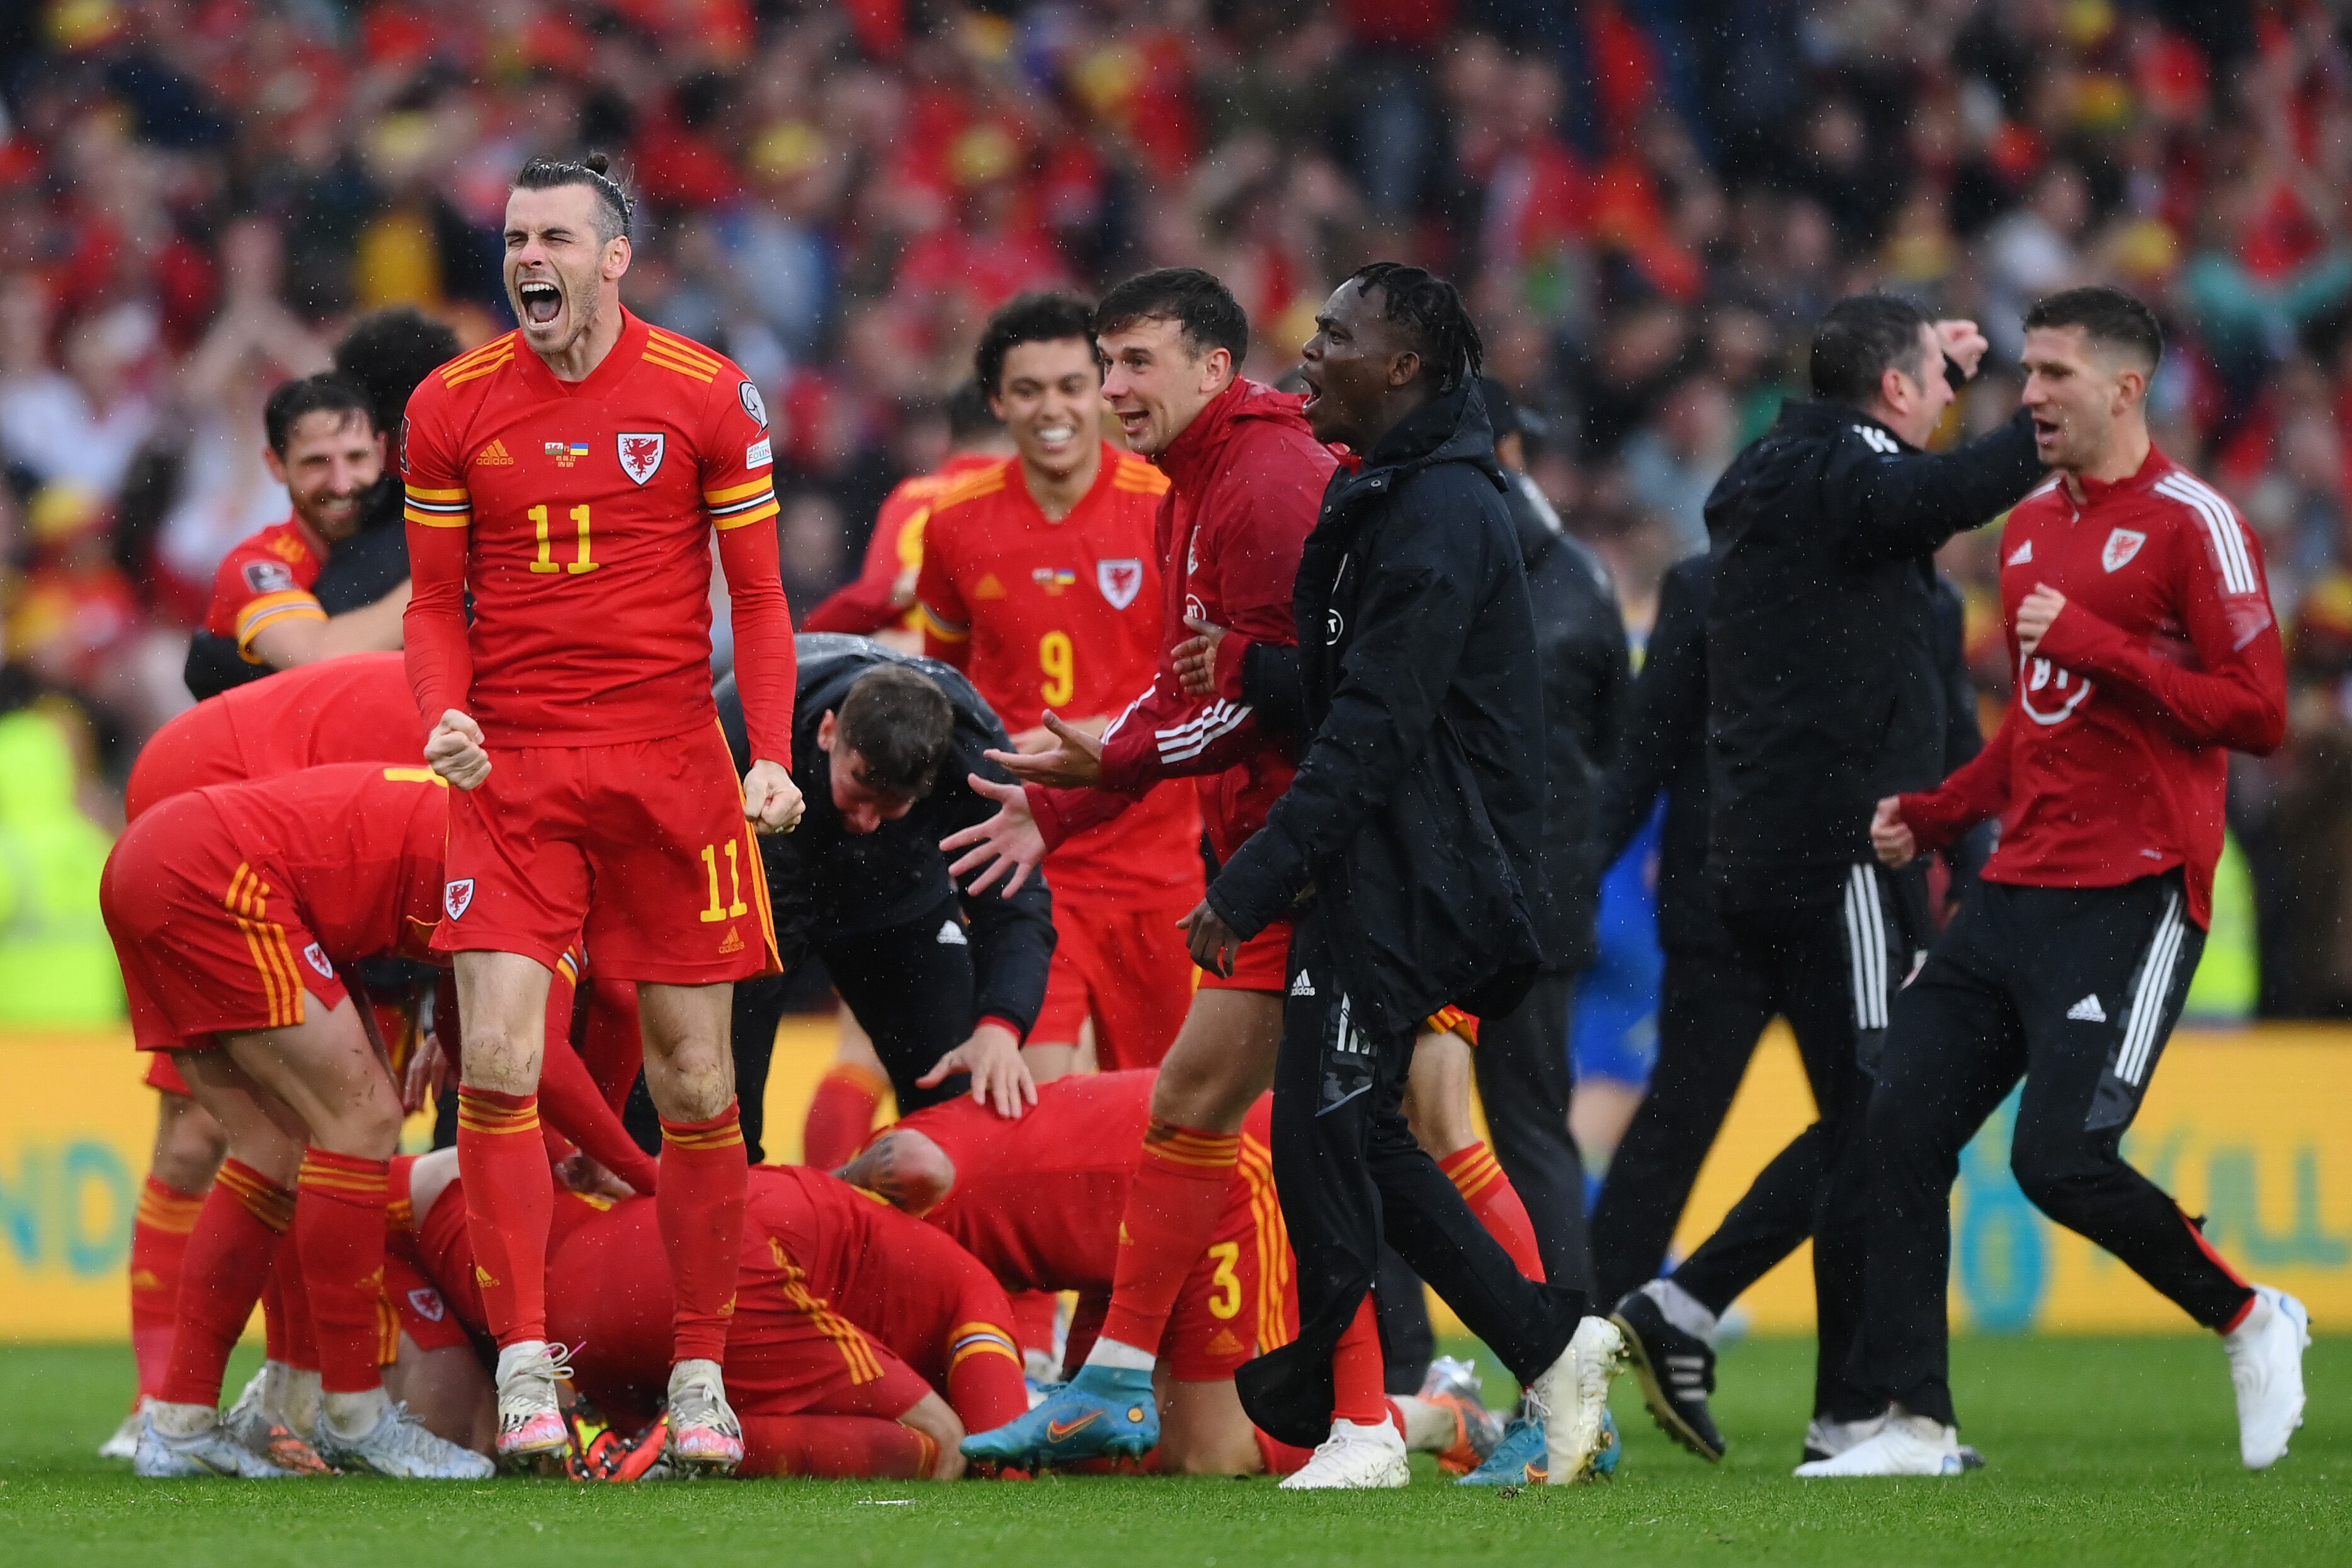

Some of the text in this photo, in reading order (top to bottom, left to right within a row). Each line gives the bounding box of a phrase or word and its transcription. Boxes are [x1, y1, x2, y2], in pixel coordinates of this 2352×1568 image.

[476, 455, 514, 465] adidas
[528, 504, 599, 574] 11
[1039, 630, 1074, 707] 9
[700, 839, 747, 923] 11
[1208, 1241, 1242, 1319] 3
